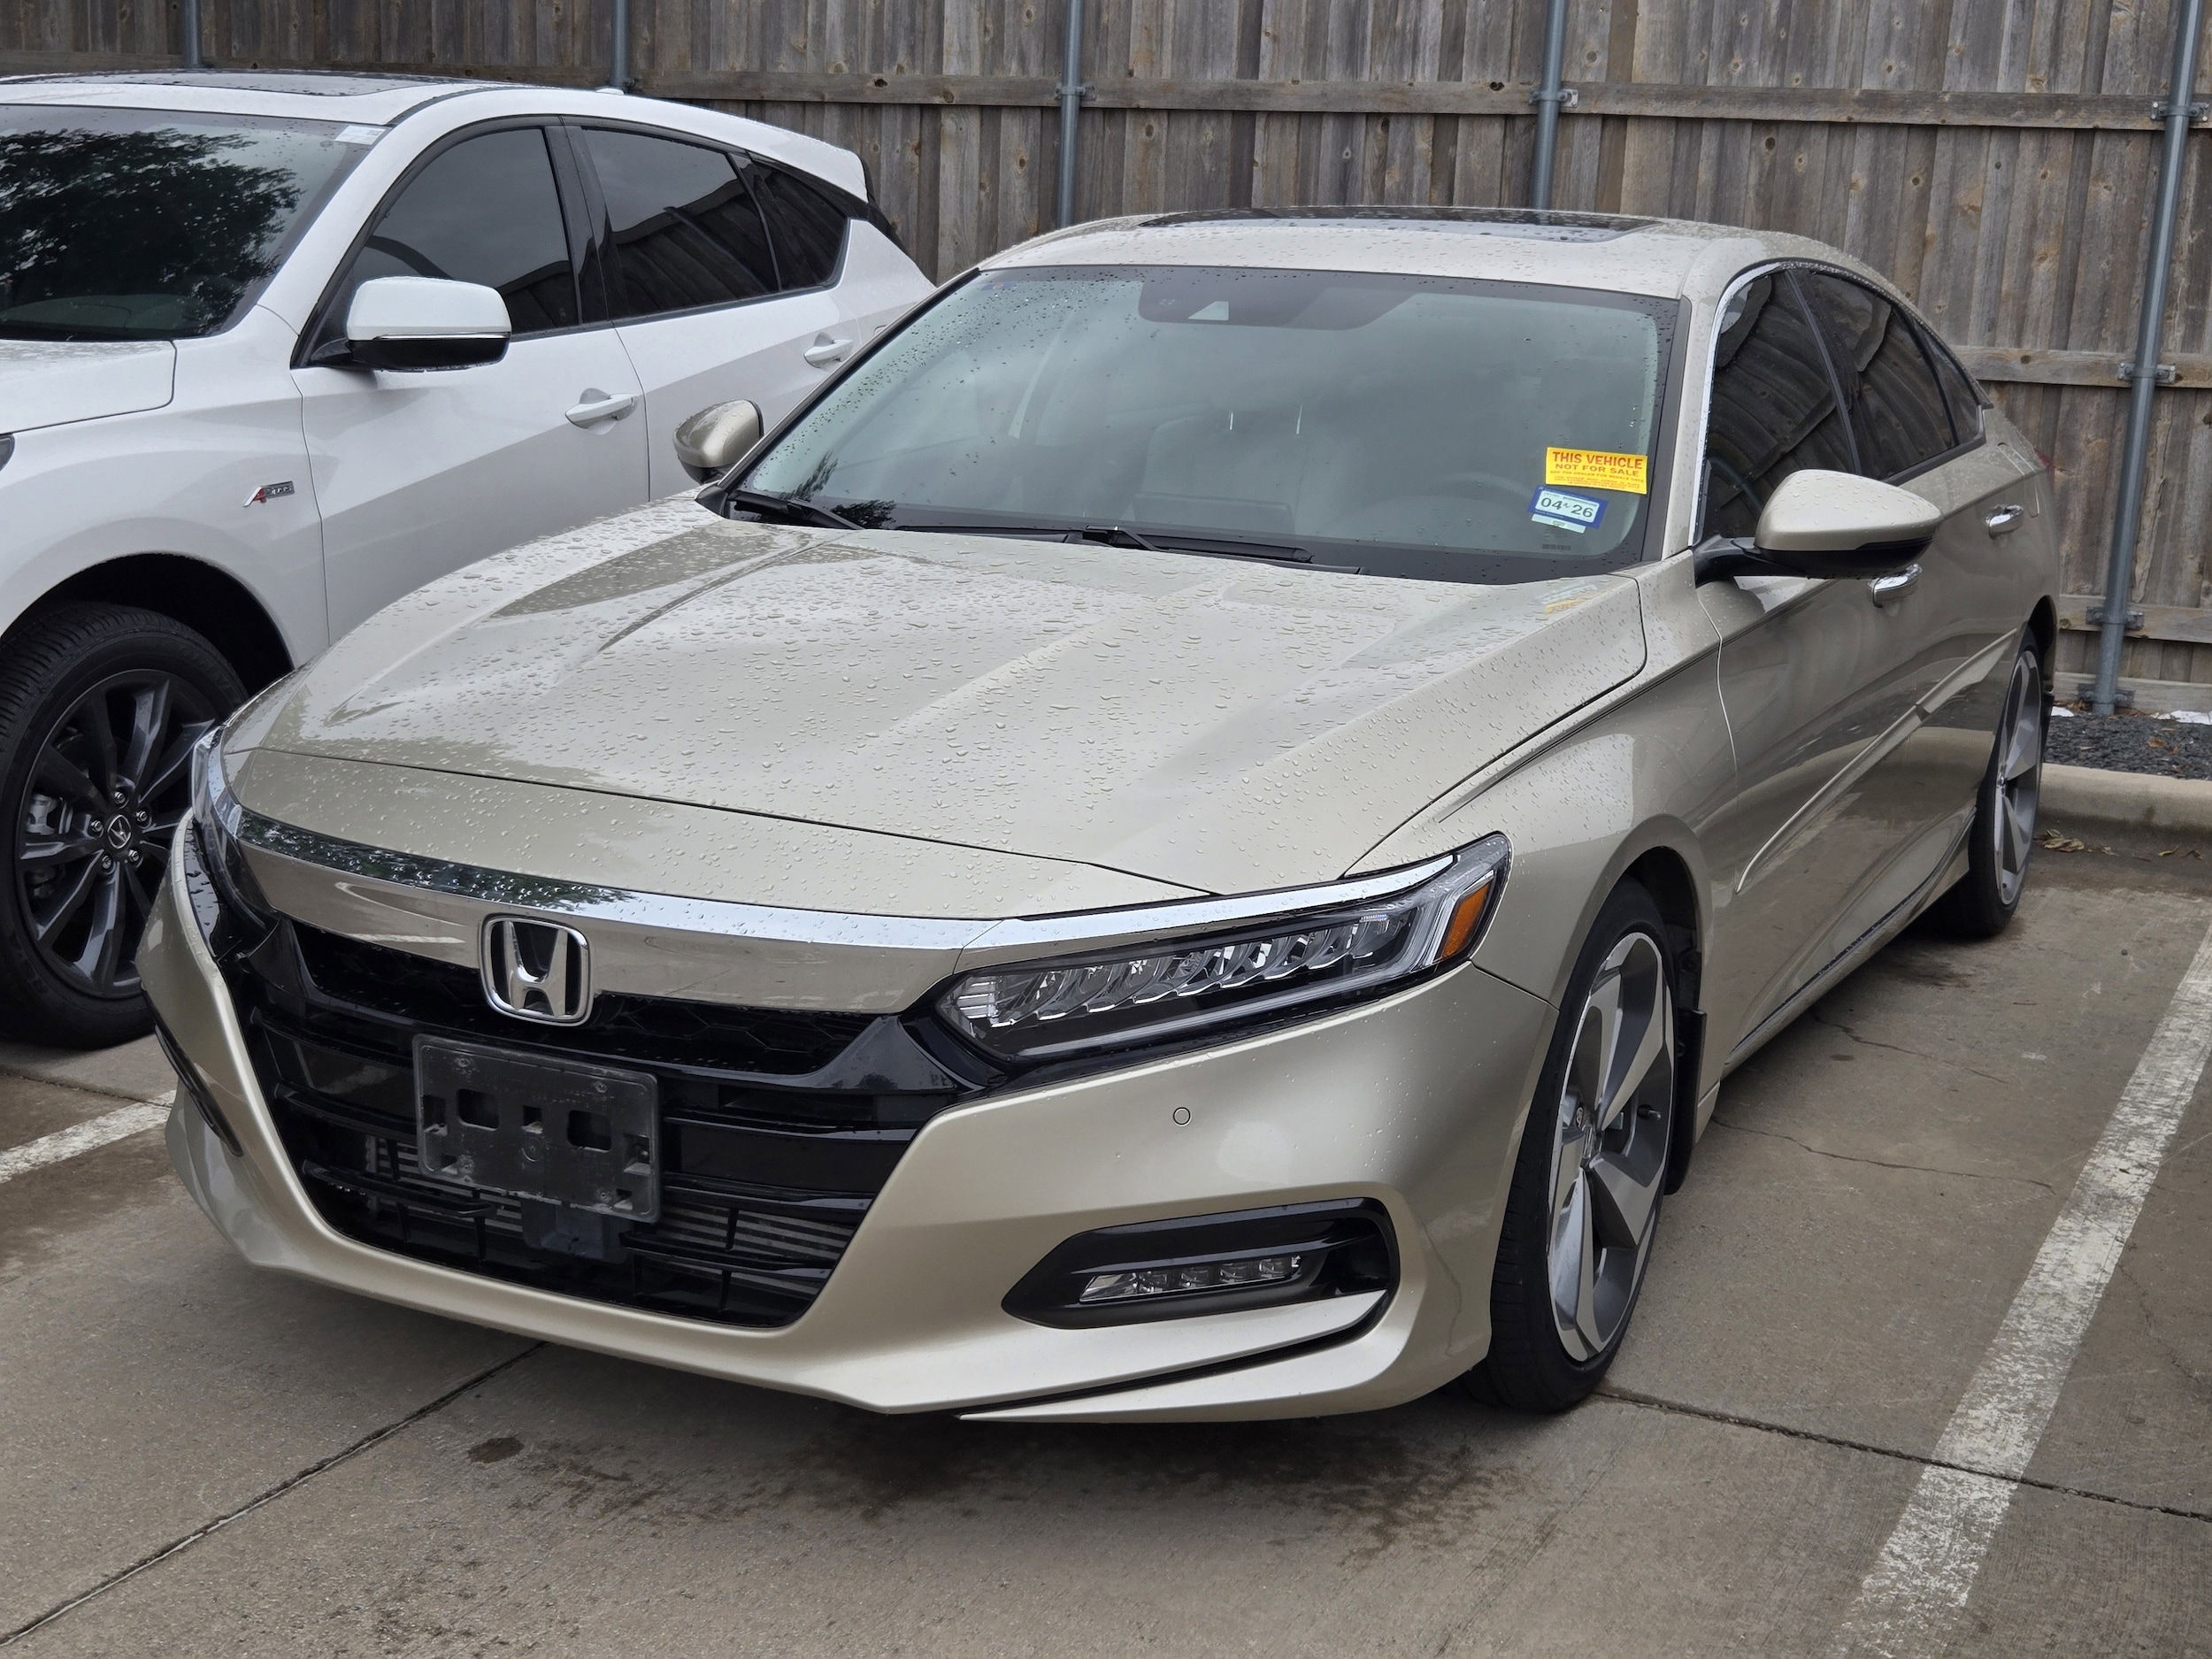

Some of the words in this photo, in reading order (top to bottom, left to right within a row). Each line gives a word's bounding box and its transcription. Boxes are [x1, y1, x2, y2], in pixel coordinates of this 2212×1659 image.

[1553, 451, 1582, 464] THIS
[1586, 454, 1643, 469] VEHICLE
[1610, 467, 1640, 477] SALE
[1540, 497, 1563, 511] 04
[1571, 504, 1594, 518] 26
